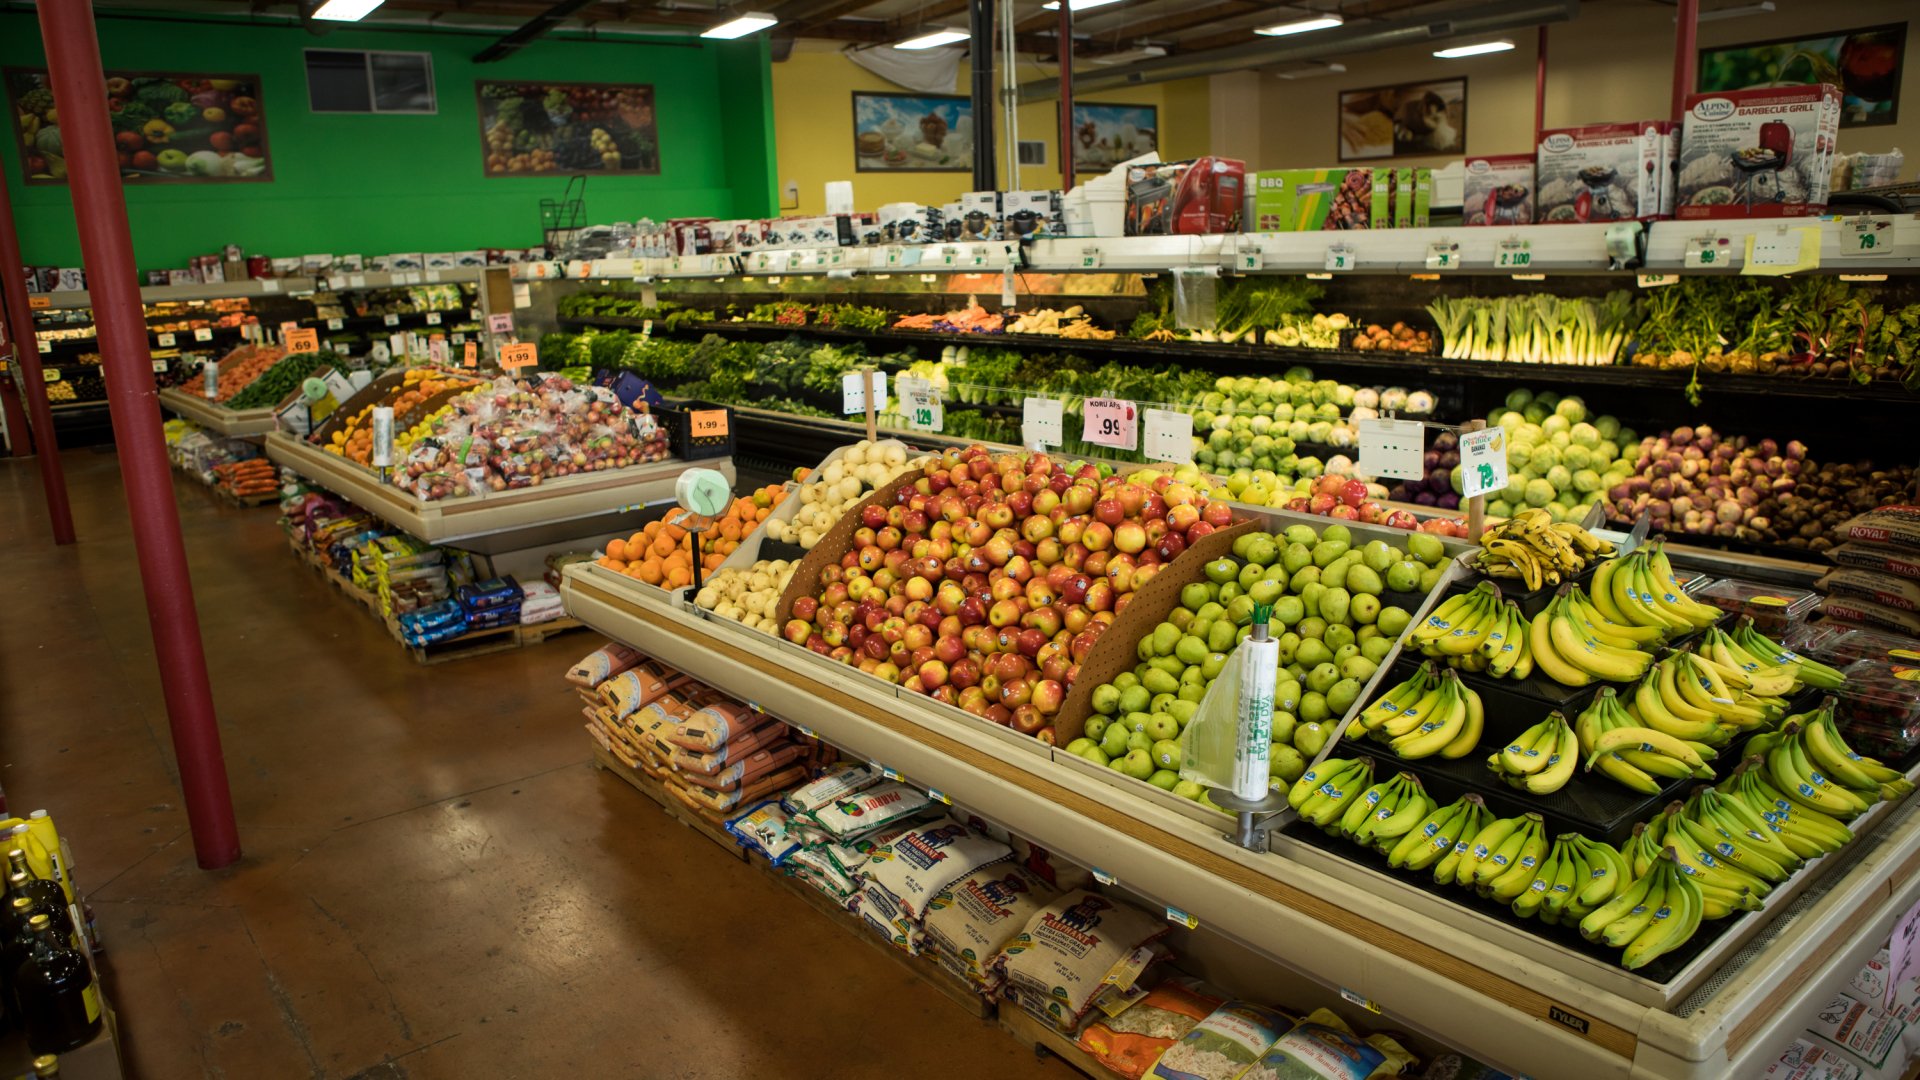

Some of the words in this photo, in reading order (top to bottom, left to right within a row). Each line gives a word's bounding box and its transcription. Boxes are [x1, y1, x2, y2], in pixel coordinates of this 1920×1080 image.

[1698, 102, 1731, 112] ALPINE
[1739, 105, 1788, 116] BARBECUE
[1789, 104, 1815, 113] GRILL
[1260, 178, 1284, 188] BBQ
[1859, 233, 1875, 249] 79
[292, 341, 311, 350] .69
[508, 353, 528, 362] 1.99
[917, 408, 931, 425] 129
[698, 421, 717, 429] 1.99
[1099, 419, 1119, 435] .99
[1477, 463, 1493, 489] 79
[1851, 526, 1886, 539] ROYAL
[1878, 594, 1912, 608] ROYAL
[1827, 606, 1861, 619] ROYAL
[864, 791, 900, 810] PARROT
[907, 834, 938, 859] ELEPHANT
[968, 884, 1002, 915] ELEPHANT
[1039, 924, 1055, 935] EXTRA
[1054, 931, 1069, 942] LONG
[1068, 938, 1087, 952] GRAIN
[1045, 918, 1090, 944] ELEPHANT
[1035, 928, 1052, 941] INDIAN
[1051, 936, 1070, 950] BASMATI
[1069, 946, 1082, 956] RICE
[1551, 1008, 1585, 1032] TYLER
